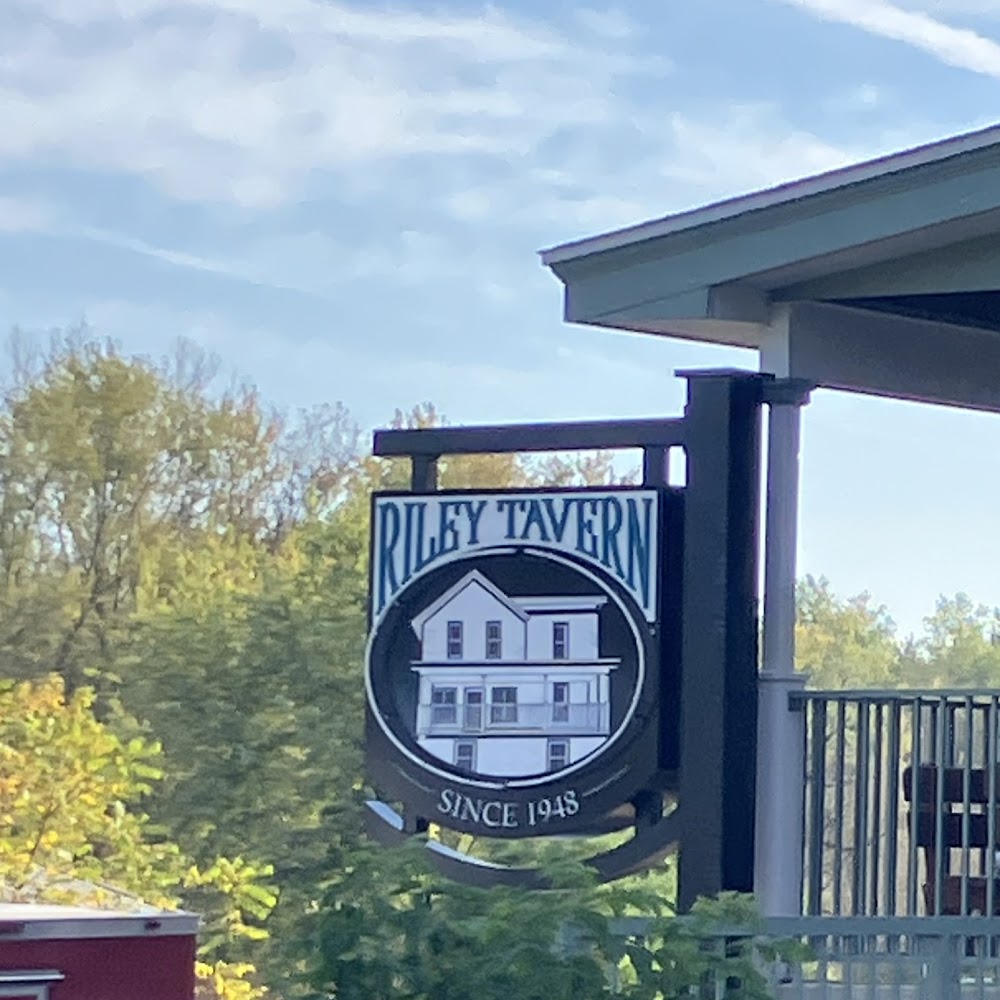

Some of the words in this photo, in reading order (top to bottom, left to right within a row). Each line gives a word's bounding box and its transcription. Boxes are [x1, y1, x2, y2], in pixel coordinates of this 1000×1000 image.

[377, 498, 487, 616] RILEY
[497, 497, 653, 612] TAVERN
[437, 789, 519, 829] SINCE
[527, 790, 580, 826] 1948
